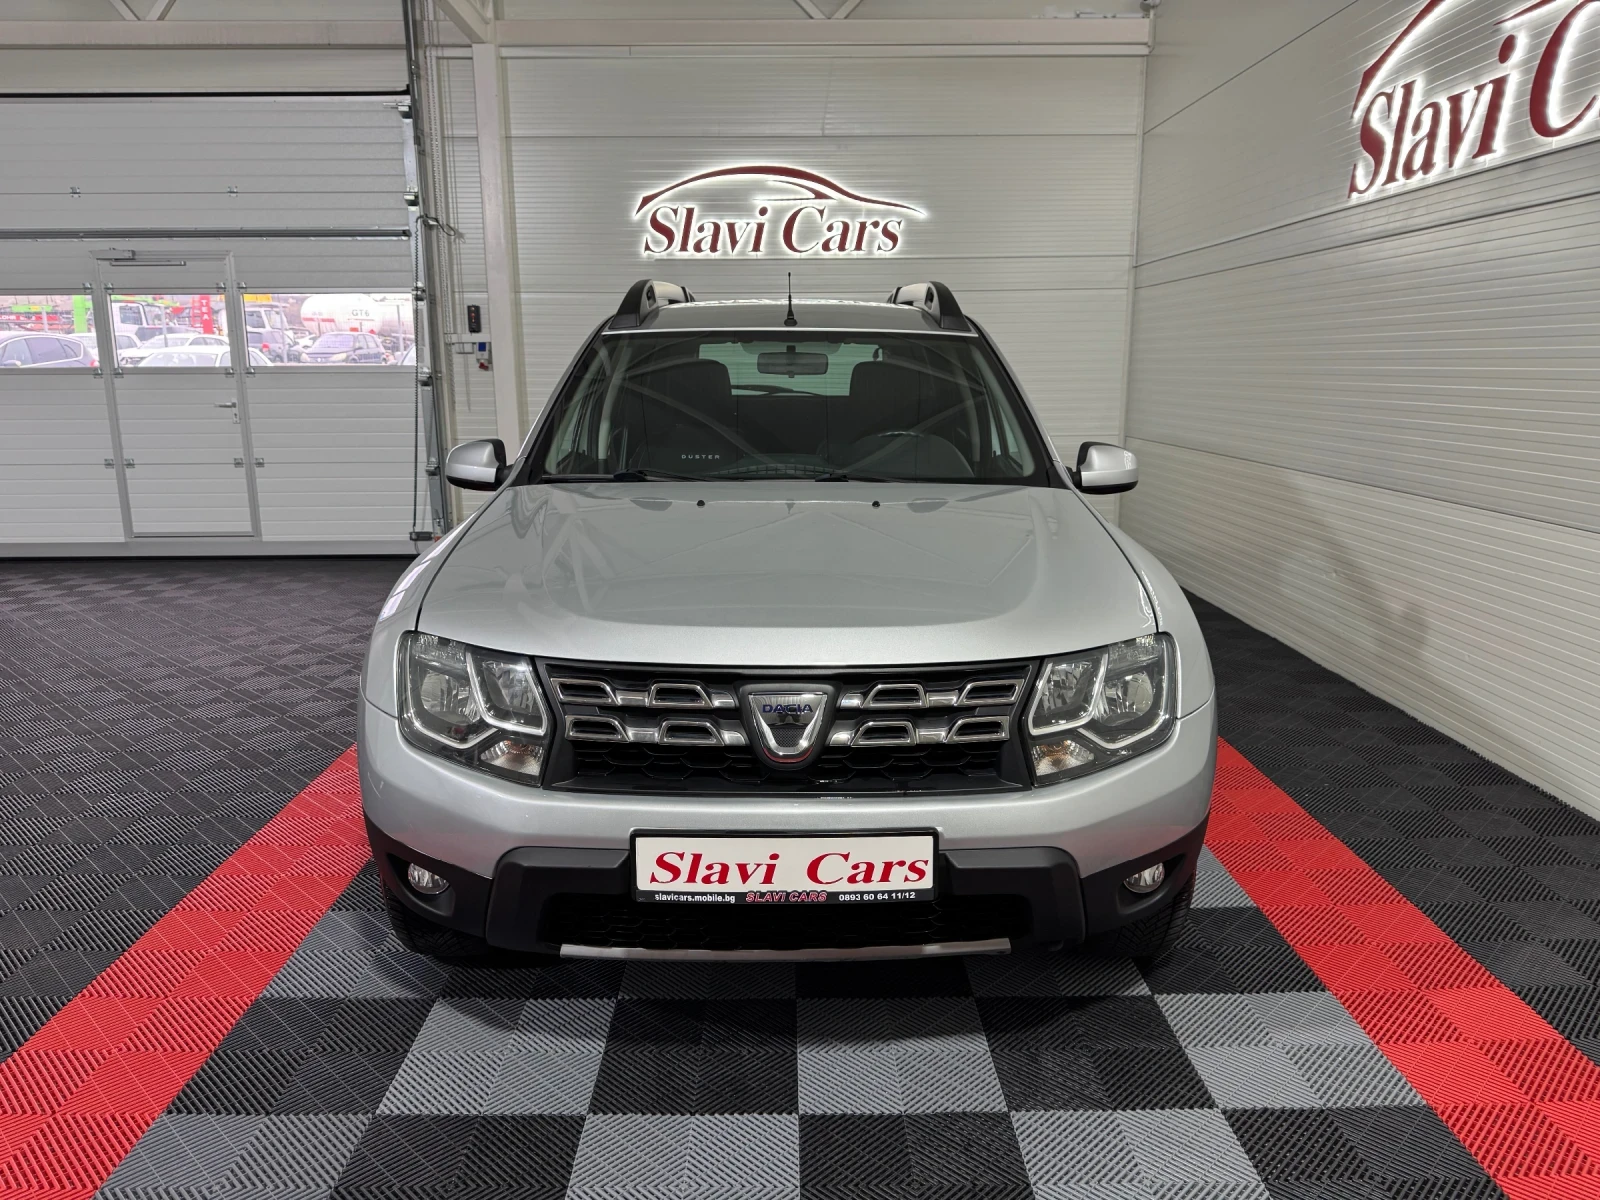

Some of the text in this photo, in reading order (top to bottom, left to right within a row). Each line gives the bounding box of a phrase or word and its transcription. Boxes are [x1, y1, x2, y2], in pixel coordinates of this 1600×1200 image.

[1348, 34, 1517, 199] Slavi
[644, 205, 903, 254] Slavi Cars
[762, 704, 813, 714] DACIA
[650, 851, 929, 885] Slavi Cars
[654, 892, 736, 904] slavicars.mobile.bg
[745, 890, 828, 903] SLAVI CARS
[838, 891, 916, 901] 0893 60 64 11/12
